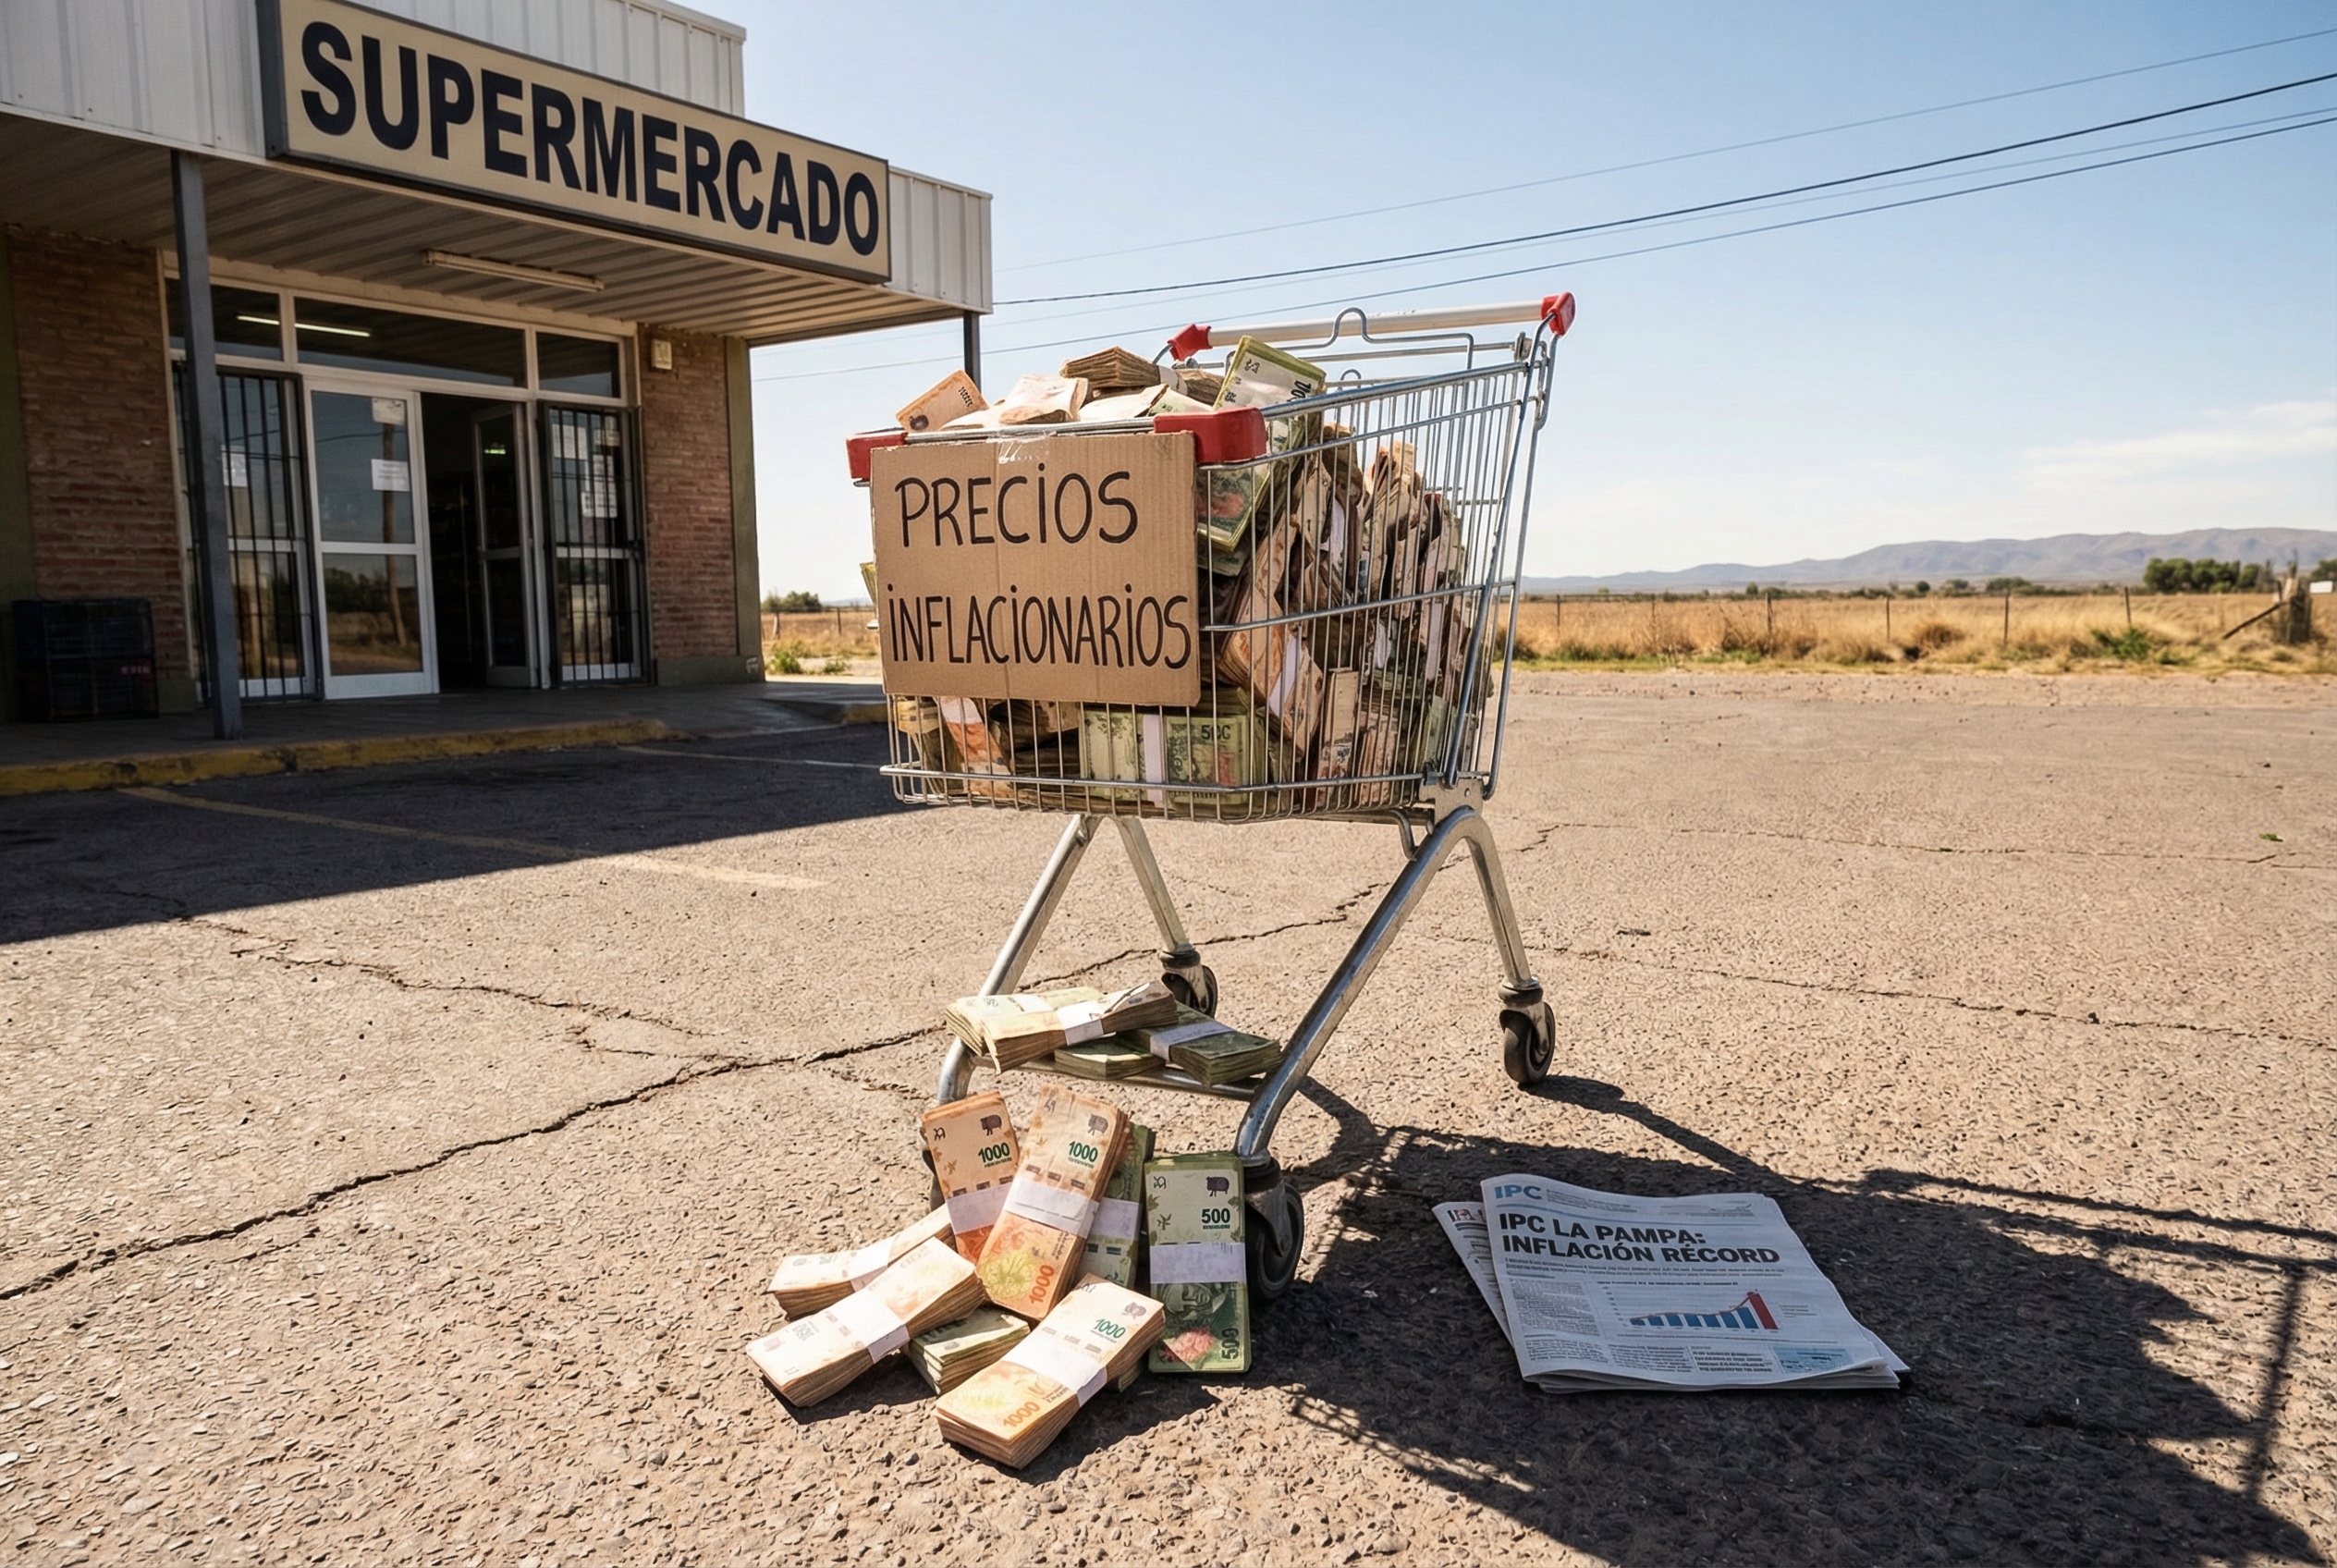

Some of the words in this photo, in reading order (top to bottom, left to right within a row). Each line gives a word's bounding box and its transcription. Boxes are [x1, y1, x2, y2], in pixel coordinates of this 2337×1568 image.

[300, 20, 880, 257] SUPERMERCADO
[977, 1141, 1010, 1163] 1000
[1069, 1141, 1098, 1162] 1000
[1494, 1184, 1542, 1200] IPC
[1201, 1207, 1231, 1223] 500
[1499, 1213, 1546, 1233] IPC
[1553, 1219, 1589, 1240] LA
[1595, 1225, 1707, 1244] PAMPA:
[1502, 1235, 1655, 1262] INFLACIÓN
[1028, 1264, 1056, 1305] 1000
[1095, 1317, 1127, 1339] 1000
[1003, 1401, 1041, 1427] 1000
